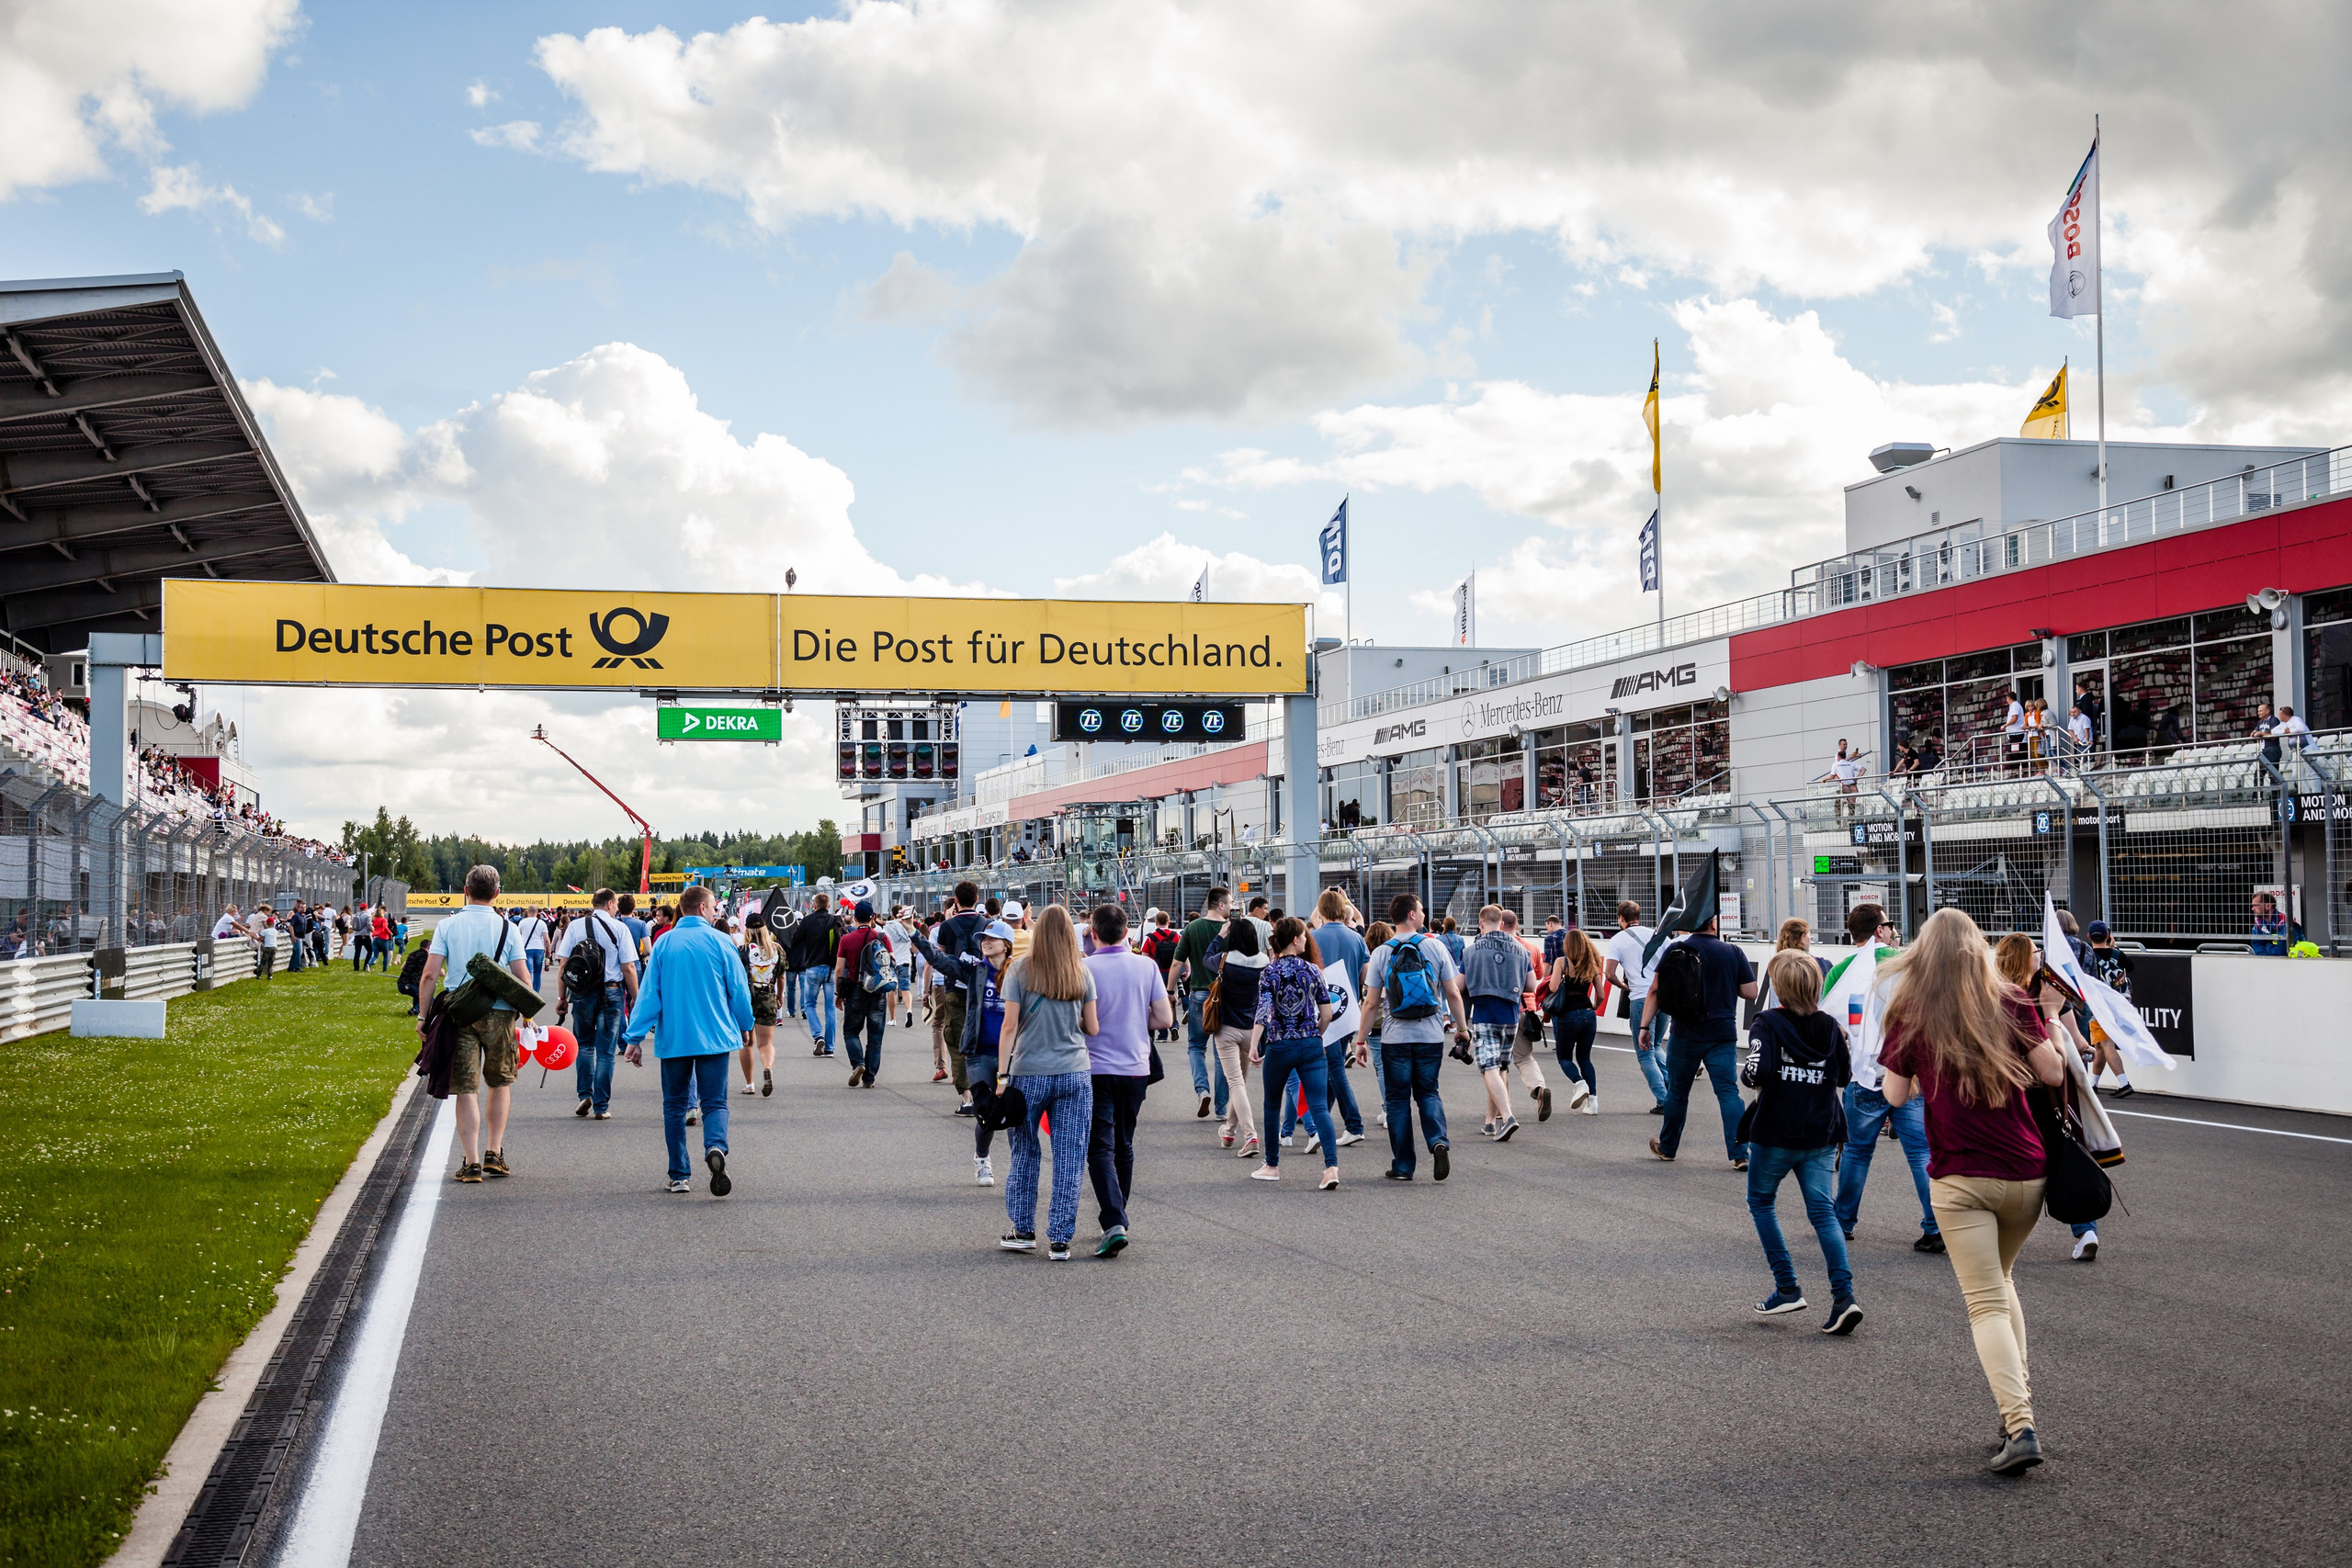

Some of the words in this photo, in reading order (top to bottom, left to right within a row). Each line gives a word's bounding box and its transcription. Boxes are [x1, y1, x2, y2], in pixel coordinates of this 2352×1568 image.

[277, 619, 472, 655] Deutsche
[486, 624, 573, 658] Post
[794, 628, 856, 662] Die
[875, 630, 954, 664] Post
[967, 629, 1025, 664] für
[1039, 633, 1282, 668] Deutschland.
[1480, 692, 1563, 728] Mercedes-Benz
[706, 716, 759, 730] DEKRA
[1081, 712, 1101, 728] ZF
[1123, 712, 1142, 729] ZF
[1163, 713, 1182, 729] ZF
[1204, 713, 1223, 730] ZF
[1317, 736, 1345, 760] es-Benz
[2301, 794, 2346, 808] MOTON
[1867, 822, 1894, 833] MOTION
[1869, 833, 1883, 843] AND
[1883, 830, 1916, 842] MOBITY
[1475, 939, 1523, 957] BROOKLYN!
[2136, 1007, 2182, 1030] ILITY
